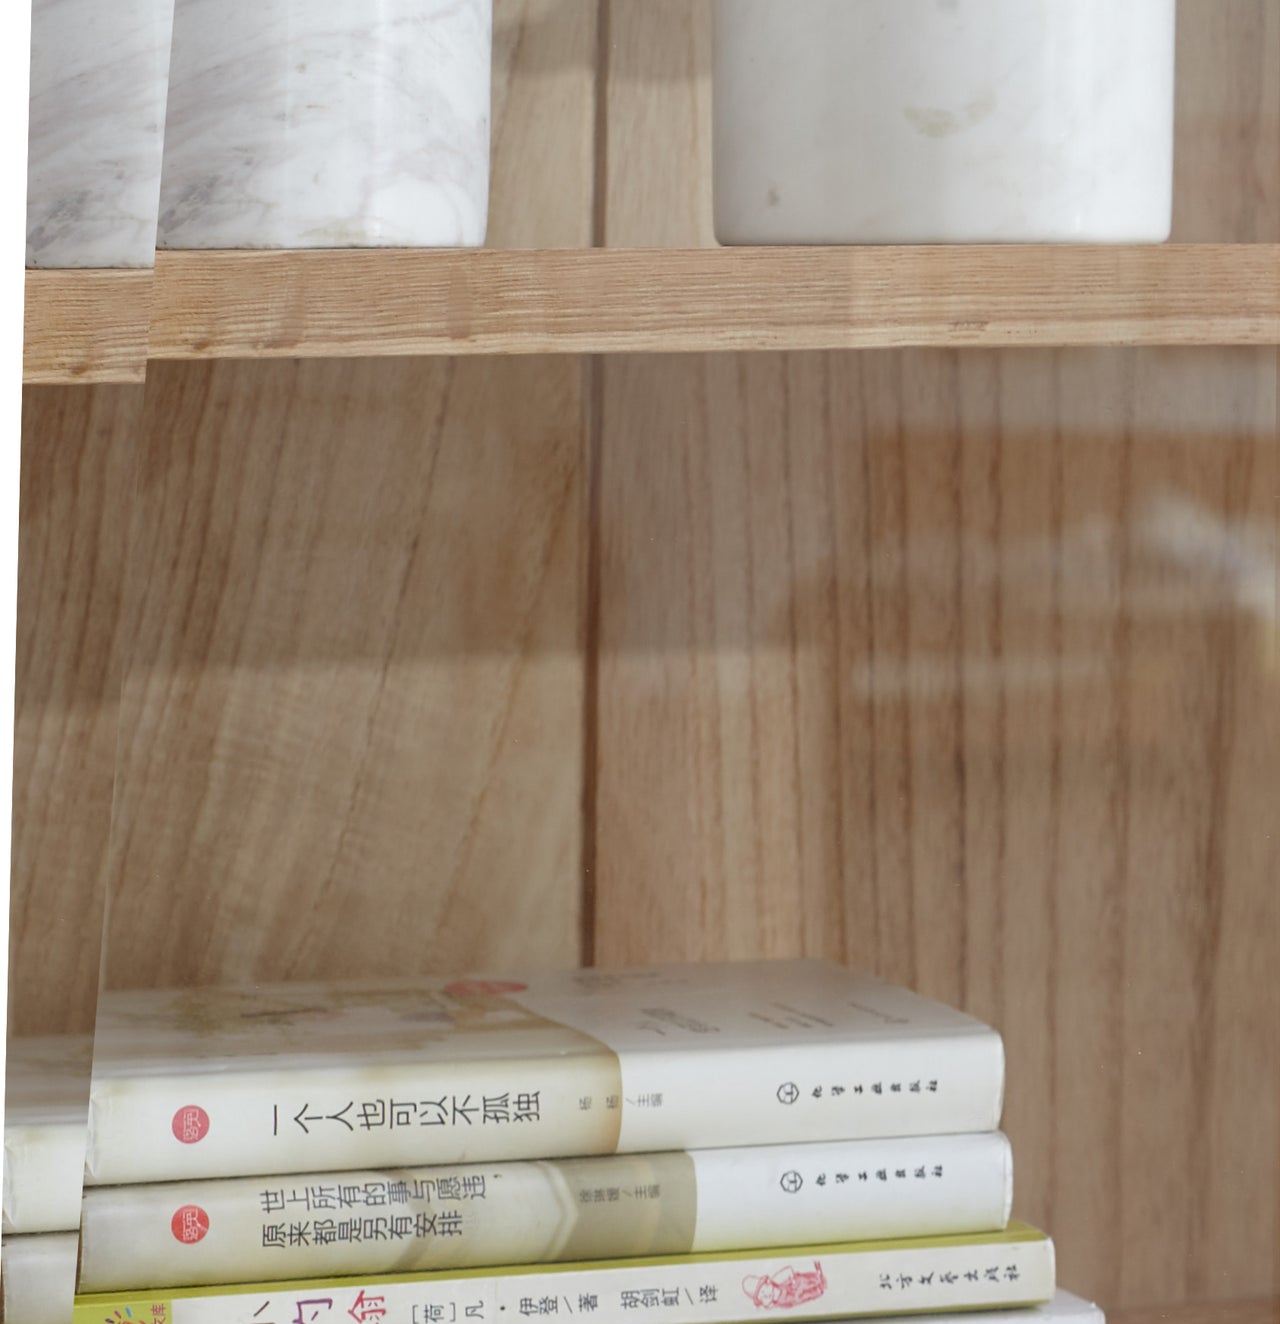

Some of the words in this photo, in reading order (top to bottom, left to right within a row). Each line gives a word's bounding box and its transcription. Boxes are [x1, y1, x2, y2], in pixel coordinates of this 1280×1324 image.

[811, 1079, 939, 1100] 化学工业出版社
[272, 1091, 541, 1136] 一个人也可以不孤独
[816, 1164, 944, 1187] 化学工业出版社
[262, 1211, 463, 1250] 原来都是另有安排
